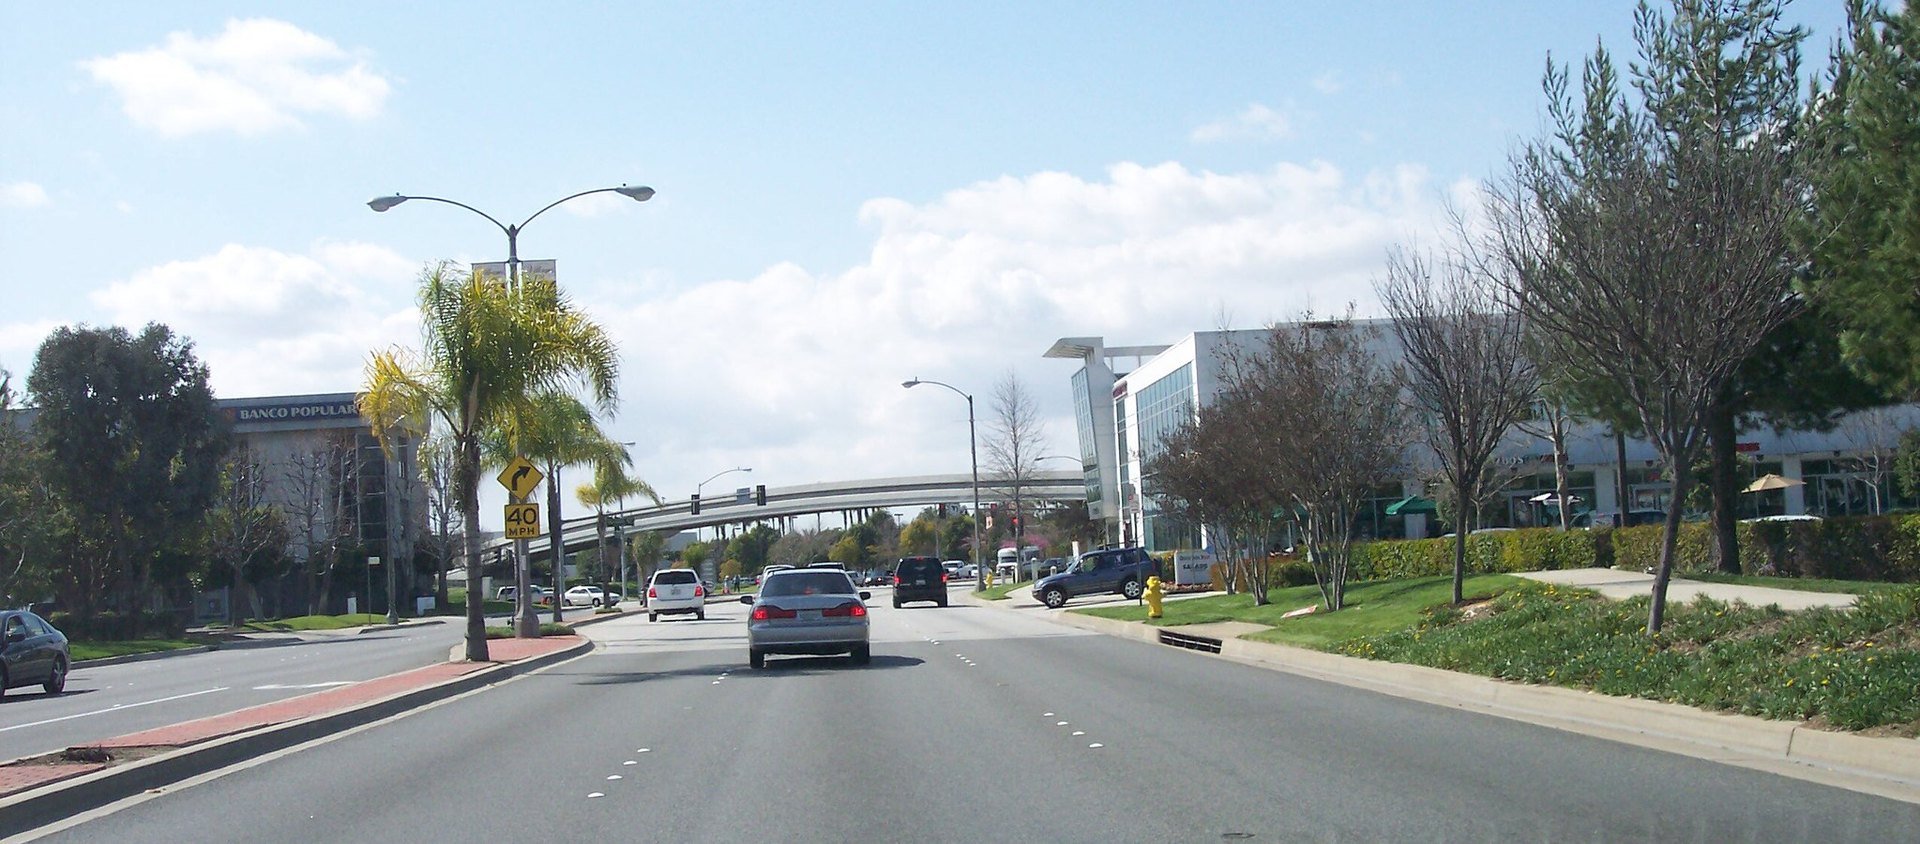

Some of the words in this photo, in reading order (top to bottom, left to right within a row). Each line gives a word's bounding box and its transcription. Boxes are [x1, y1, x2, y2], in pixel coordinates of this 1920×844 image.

[240, 407, 288, 419] BANCO
[291, 404, 358, 417] POPULAR
[507, 508, 537, 525] 40
[509, 527, 535, 536] MPH
